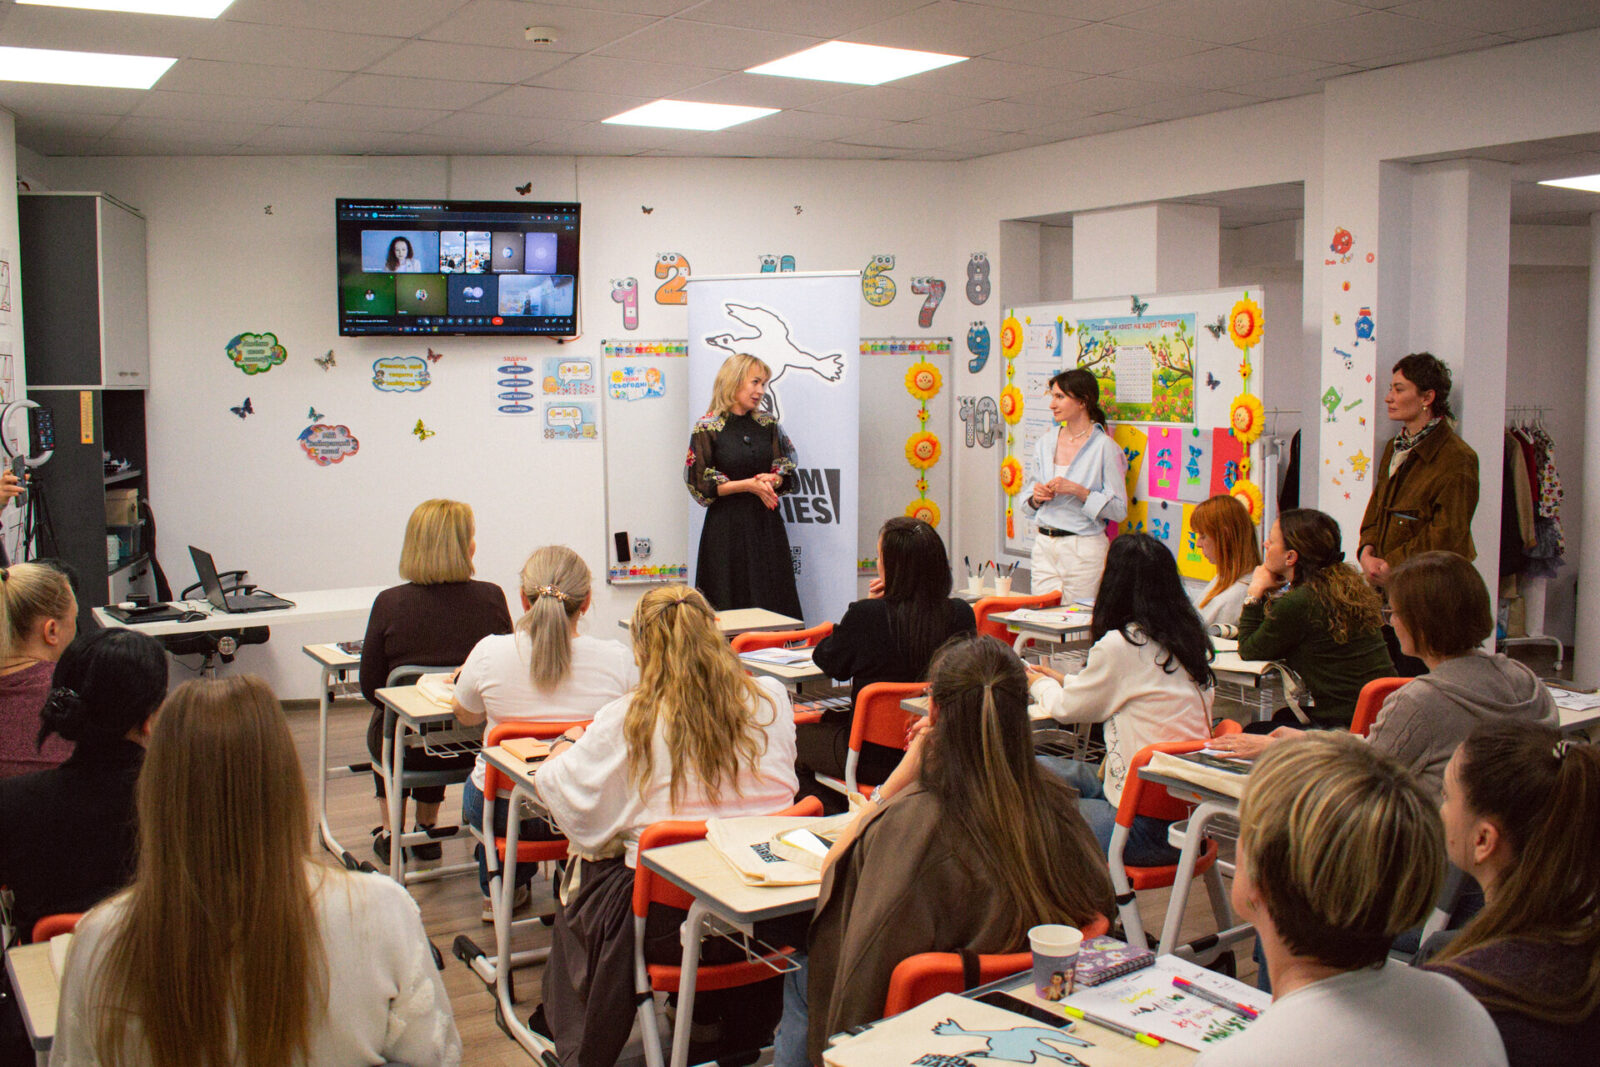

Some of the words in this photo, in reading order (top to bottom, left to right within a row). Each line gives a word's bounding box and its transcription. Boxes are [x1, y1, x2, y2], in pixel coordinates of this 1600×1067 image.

[862, 254, 897, 307] 6
[911, 277, 947, 329] 7
[967, 321, 991, 374] 9
[958, 395, 998, 449] 10
